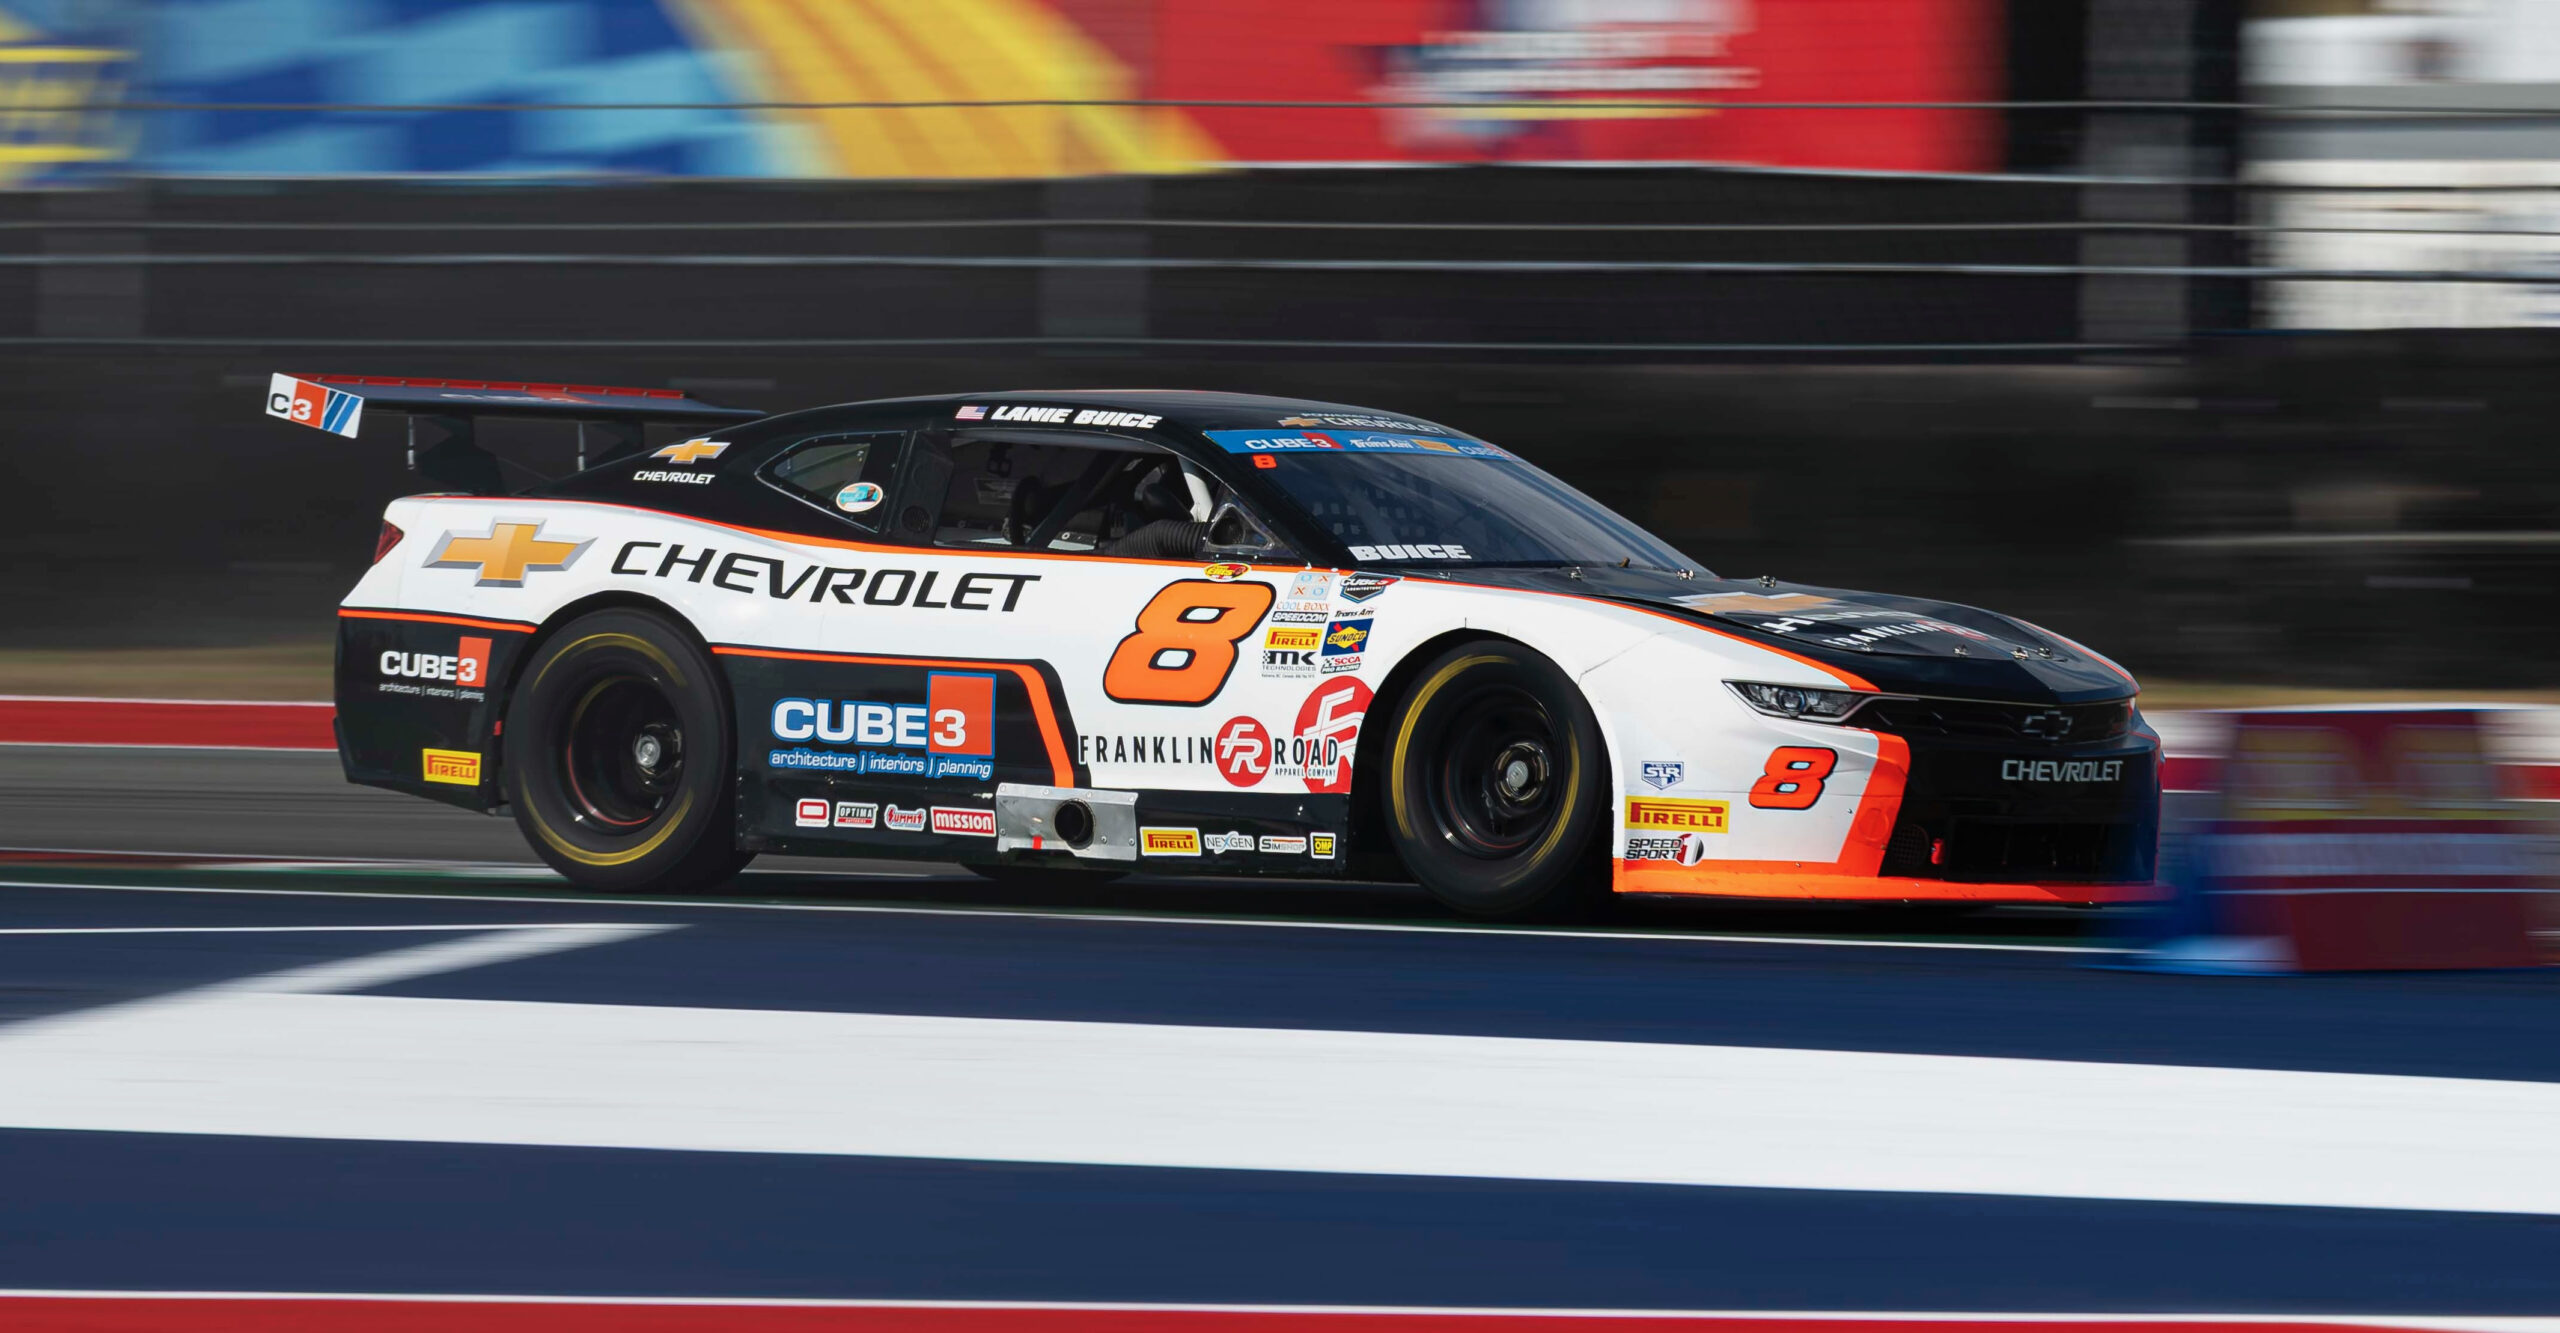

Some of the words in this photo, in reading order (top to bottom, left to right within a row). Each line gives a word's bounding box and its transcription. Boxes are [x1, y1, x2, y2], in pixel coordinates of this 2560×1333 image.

[270, 392, 312, 421] C3
[990, 406, 1073, 423] LANIE
[1073, 409, 1163, 429] BUICE
[1321, 417, 1448, 435] CHEVROLET
[1244, 437, 1332, 449] CUBE3
[1252, 454, 1278, 469] 8
[633, 470, 716, 485] CHEVROLET
[1347, 544, 1473, 561] BUICE
[609, 540, 1043, 612] CHEVROLET
[1276, 601, 1301, 610] COOL
[1303, 602, 1329, 611] BOXX
[1272, 612, 1327, 622] SPEEDCOM
[1270, 631, 1318, 646] PIRELLI
[1329, 631, 1366, 643] SUNOCO
[1822, 622, 1941, 646] FRANKLIN
[1103, 578, 1276, 707] 8
[380, 650, 478, 682] CUBE3
[1334, 656, 1361, 666] SCCA
[773, 700, 967, 748] CUBE3
[1079, 735, 1213, 764] FRANKLIN
[1274, 737, 1338, 766] ROAD
[427, 754, 478, 779] PIRELLI
[771, 751, 856, 768] architecture
[869, 754, 924, 772] interiors
[937, 760, 991, 778] planning
[1274, 767, 1304, 776] APPAREL
[1307, 768, 1336, 777] COMPANY
[1643, 766, 1682, 778] SLR
[2002, 760, 2123, 782] CHEVROLET
[1748, 745, 1839, 810] 8
[839, 806, 873, 818] OPTIMA
[1630, 802, 1725, 828] PIRELLI
[1148, 833, 1194, 849] PIRELLI
[1315, 840, 1333, 851] OMP
[1628, 838, 1683, 849] SPEED
[1625, 849, 1680, 860] SPORT
